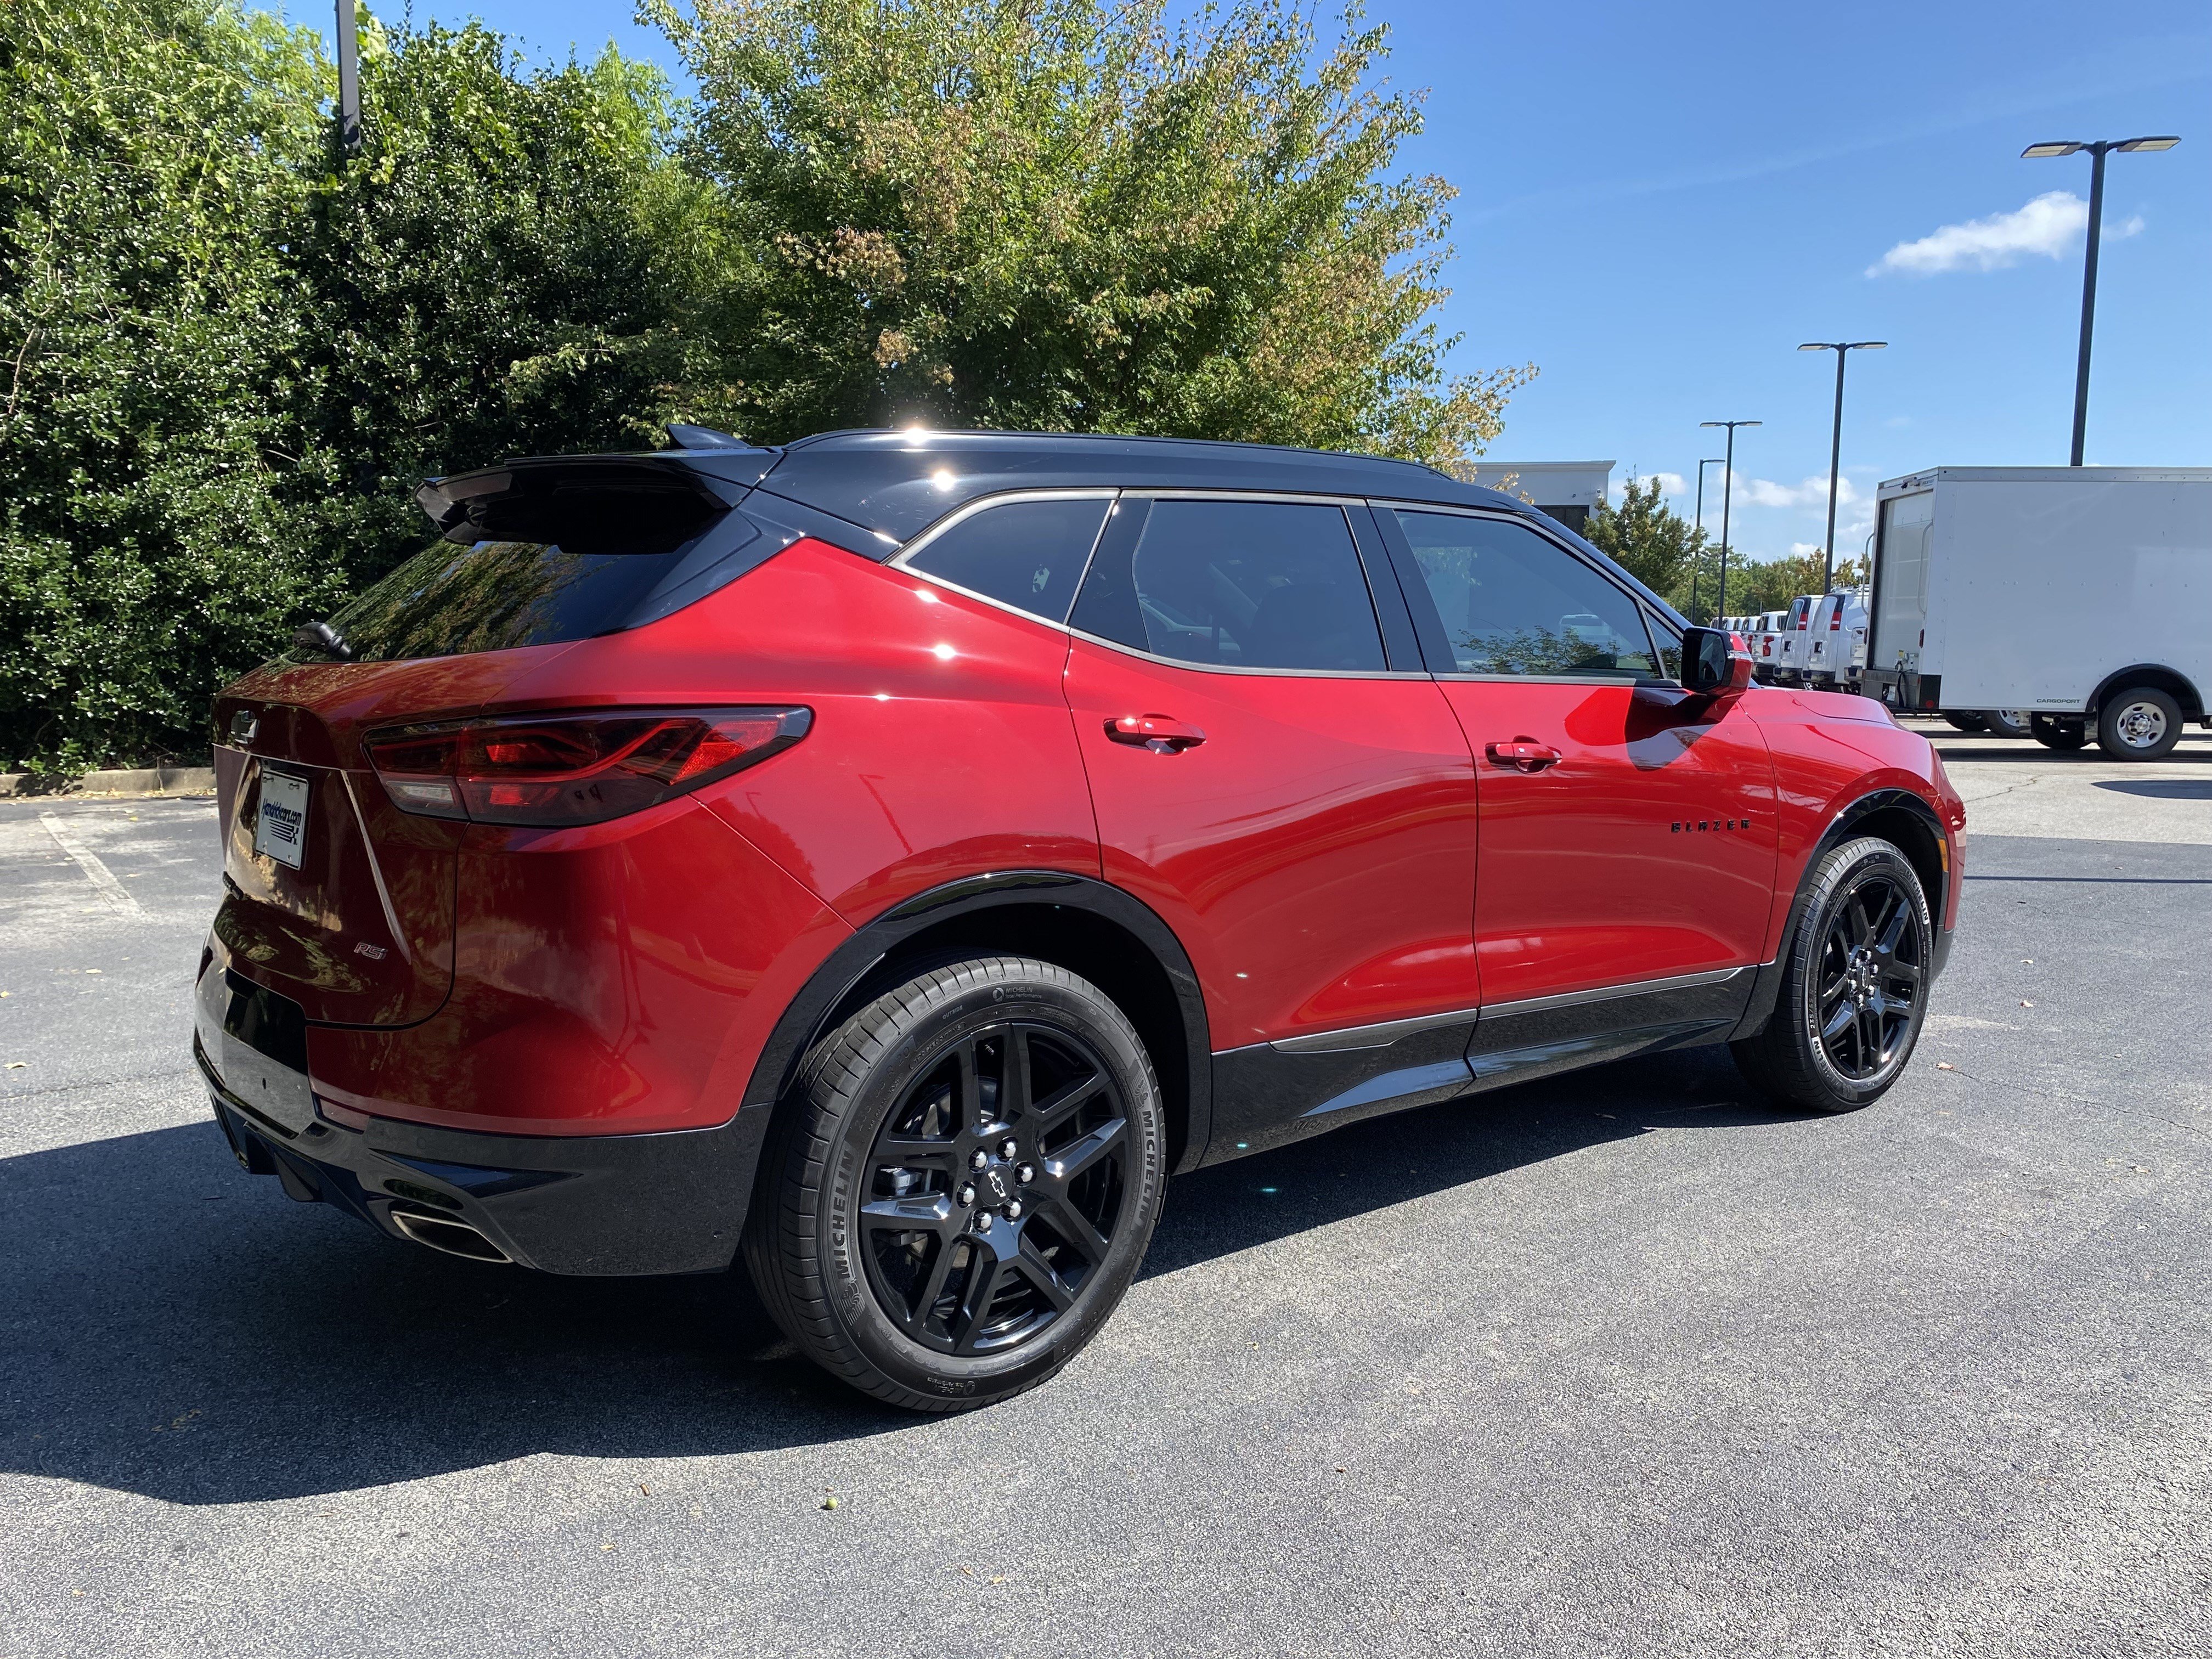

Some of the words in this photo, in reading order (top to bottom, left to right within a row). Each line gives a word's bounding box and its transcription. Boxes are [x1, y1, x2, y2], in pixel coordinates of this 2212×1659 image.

[1671, 818, 1750, 833] BLAZER
[1905, 869, 1928, 921] MICHELIN
[354, 942, 386, 960] RS
[942, 1005, 963, 1019] OUTSIDE
[1139, 1110, 1155, 1223] MICHELIN
[832, 1150, 854, 1279] MICHELIN
